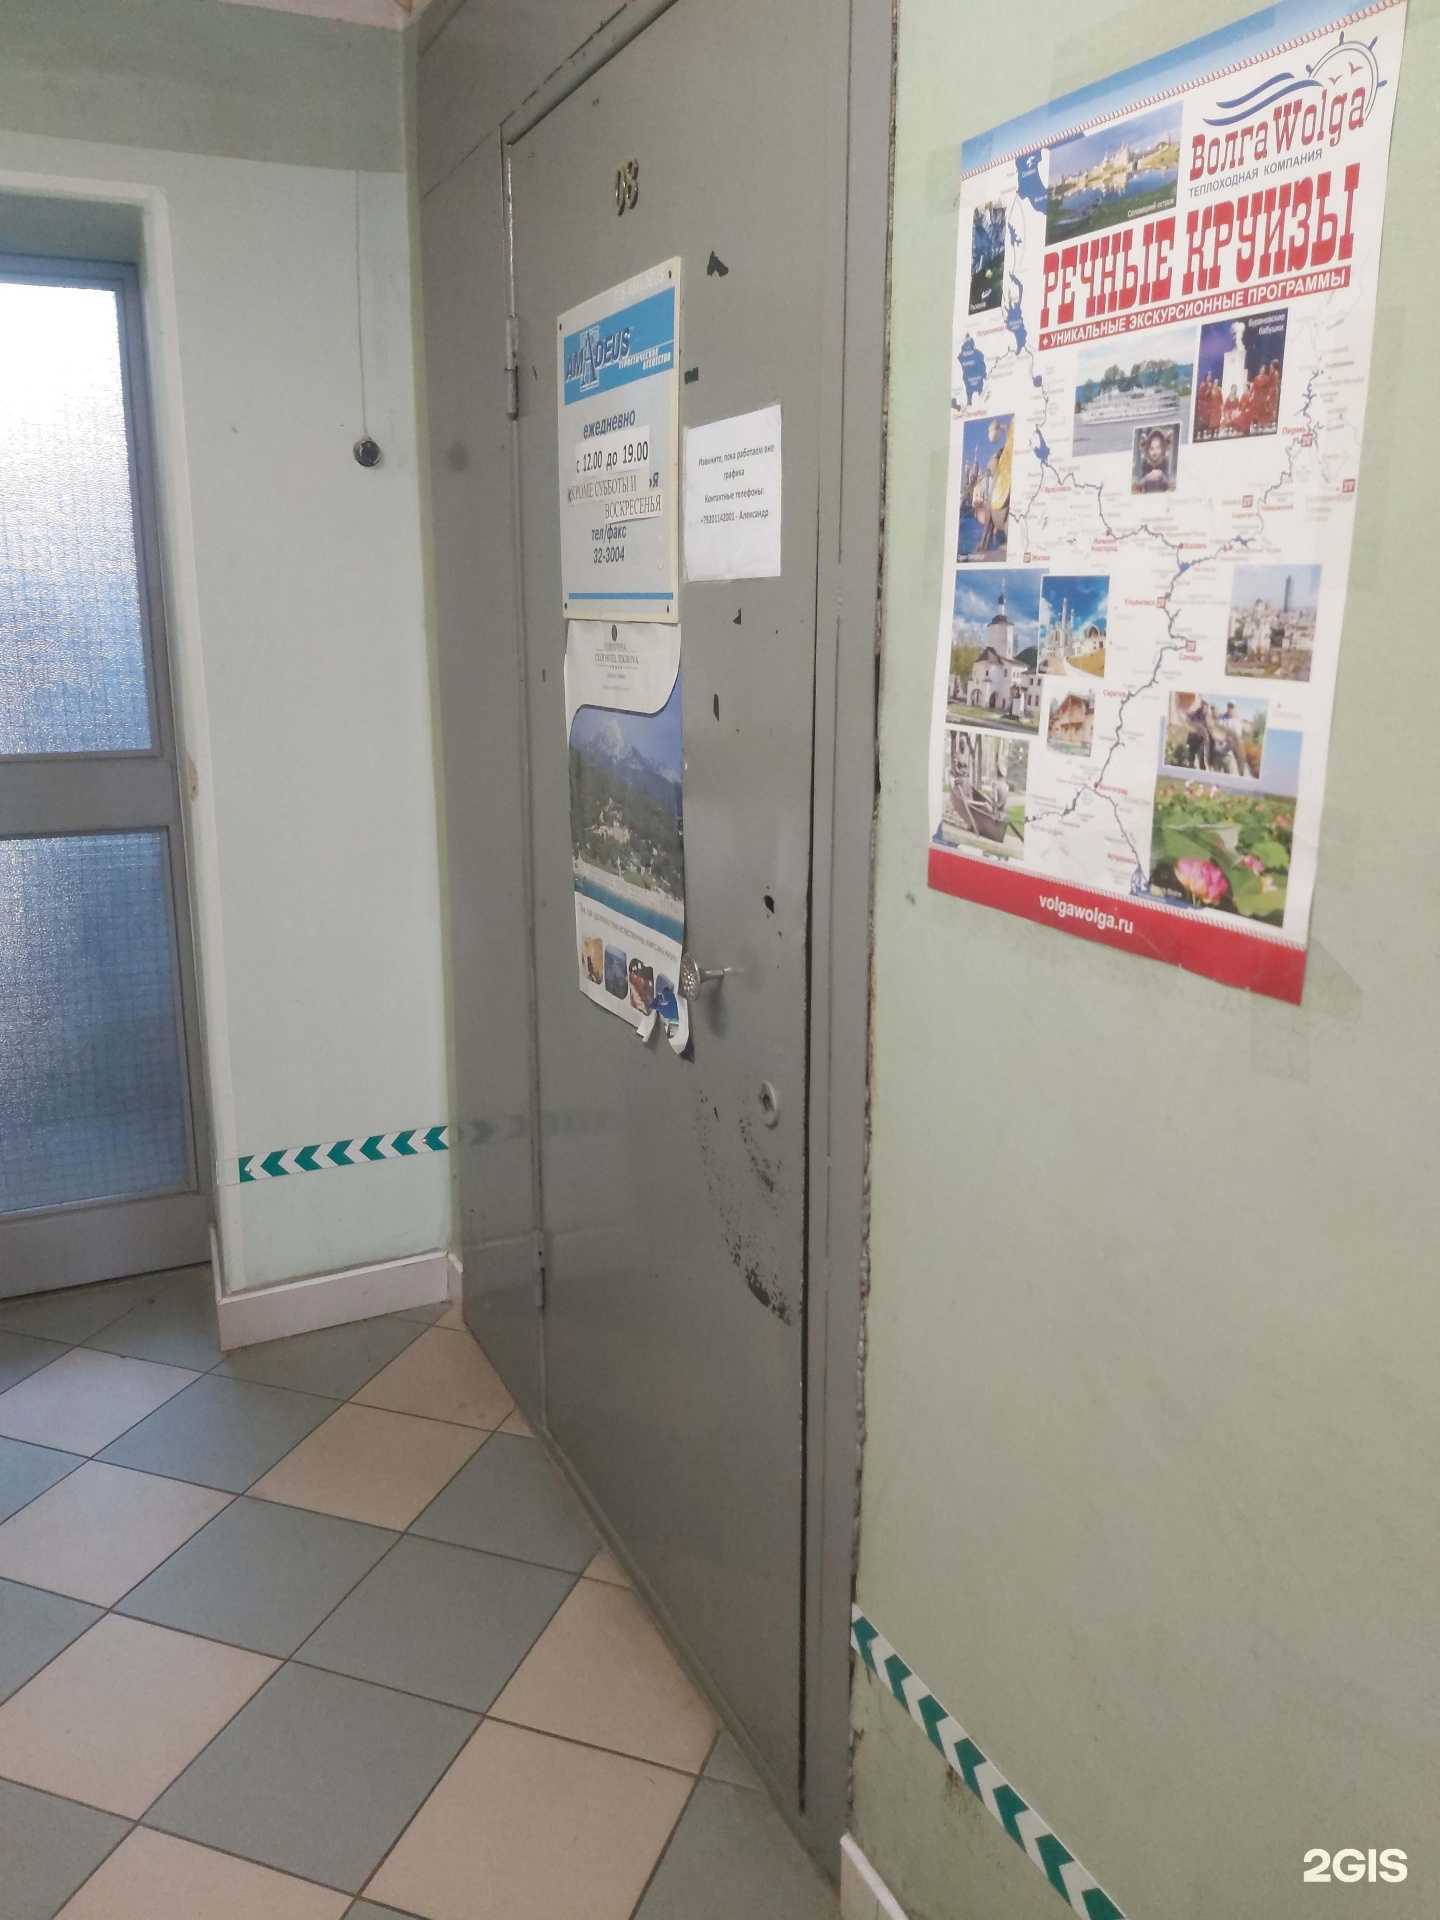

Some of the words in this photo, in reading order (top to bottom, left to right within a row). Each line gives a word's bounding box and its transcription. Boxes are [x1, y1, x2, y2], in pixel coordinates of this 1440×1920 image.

[1190, 167, 1259, 198] ТЕПЛОХОДНАЯ
[1264, 149, 1323, 176] КОМПАНИЯ
[1040, 216, 1176, 328] РЕЧНЫЕ
[1182, 163, 1360, 295] КРУИЗЫ
[1050, 318, 1127, 346] УНИКАЛЬНЫЕ
[1128, 294, 1245, 331] ЭКСКУРСИОННЫЕ
[1248, 269, 1346, 304] ПРОГРАММЫ
[583, 409, 636, 439] ежедневно
[583, 450, 602, 472] 12.00
[606, 451, 618, 471] до
[622, 441, 648, 464] 19.00
[604, 494, 662, 520] ВОСКРЕСЕНЬЯ
[591, 524, 626, 544] тел/факс
[593, 546, 625, 564] 32-3004
[1039, 895, 1134, 934] volgawolga.ru
